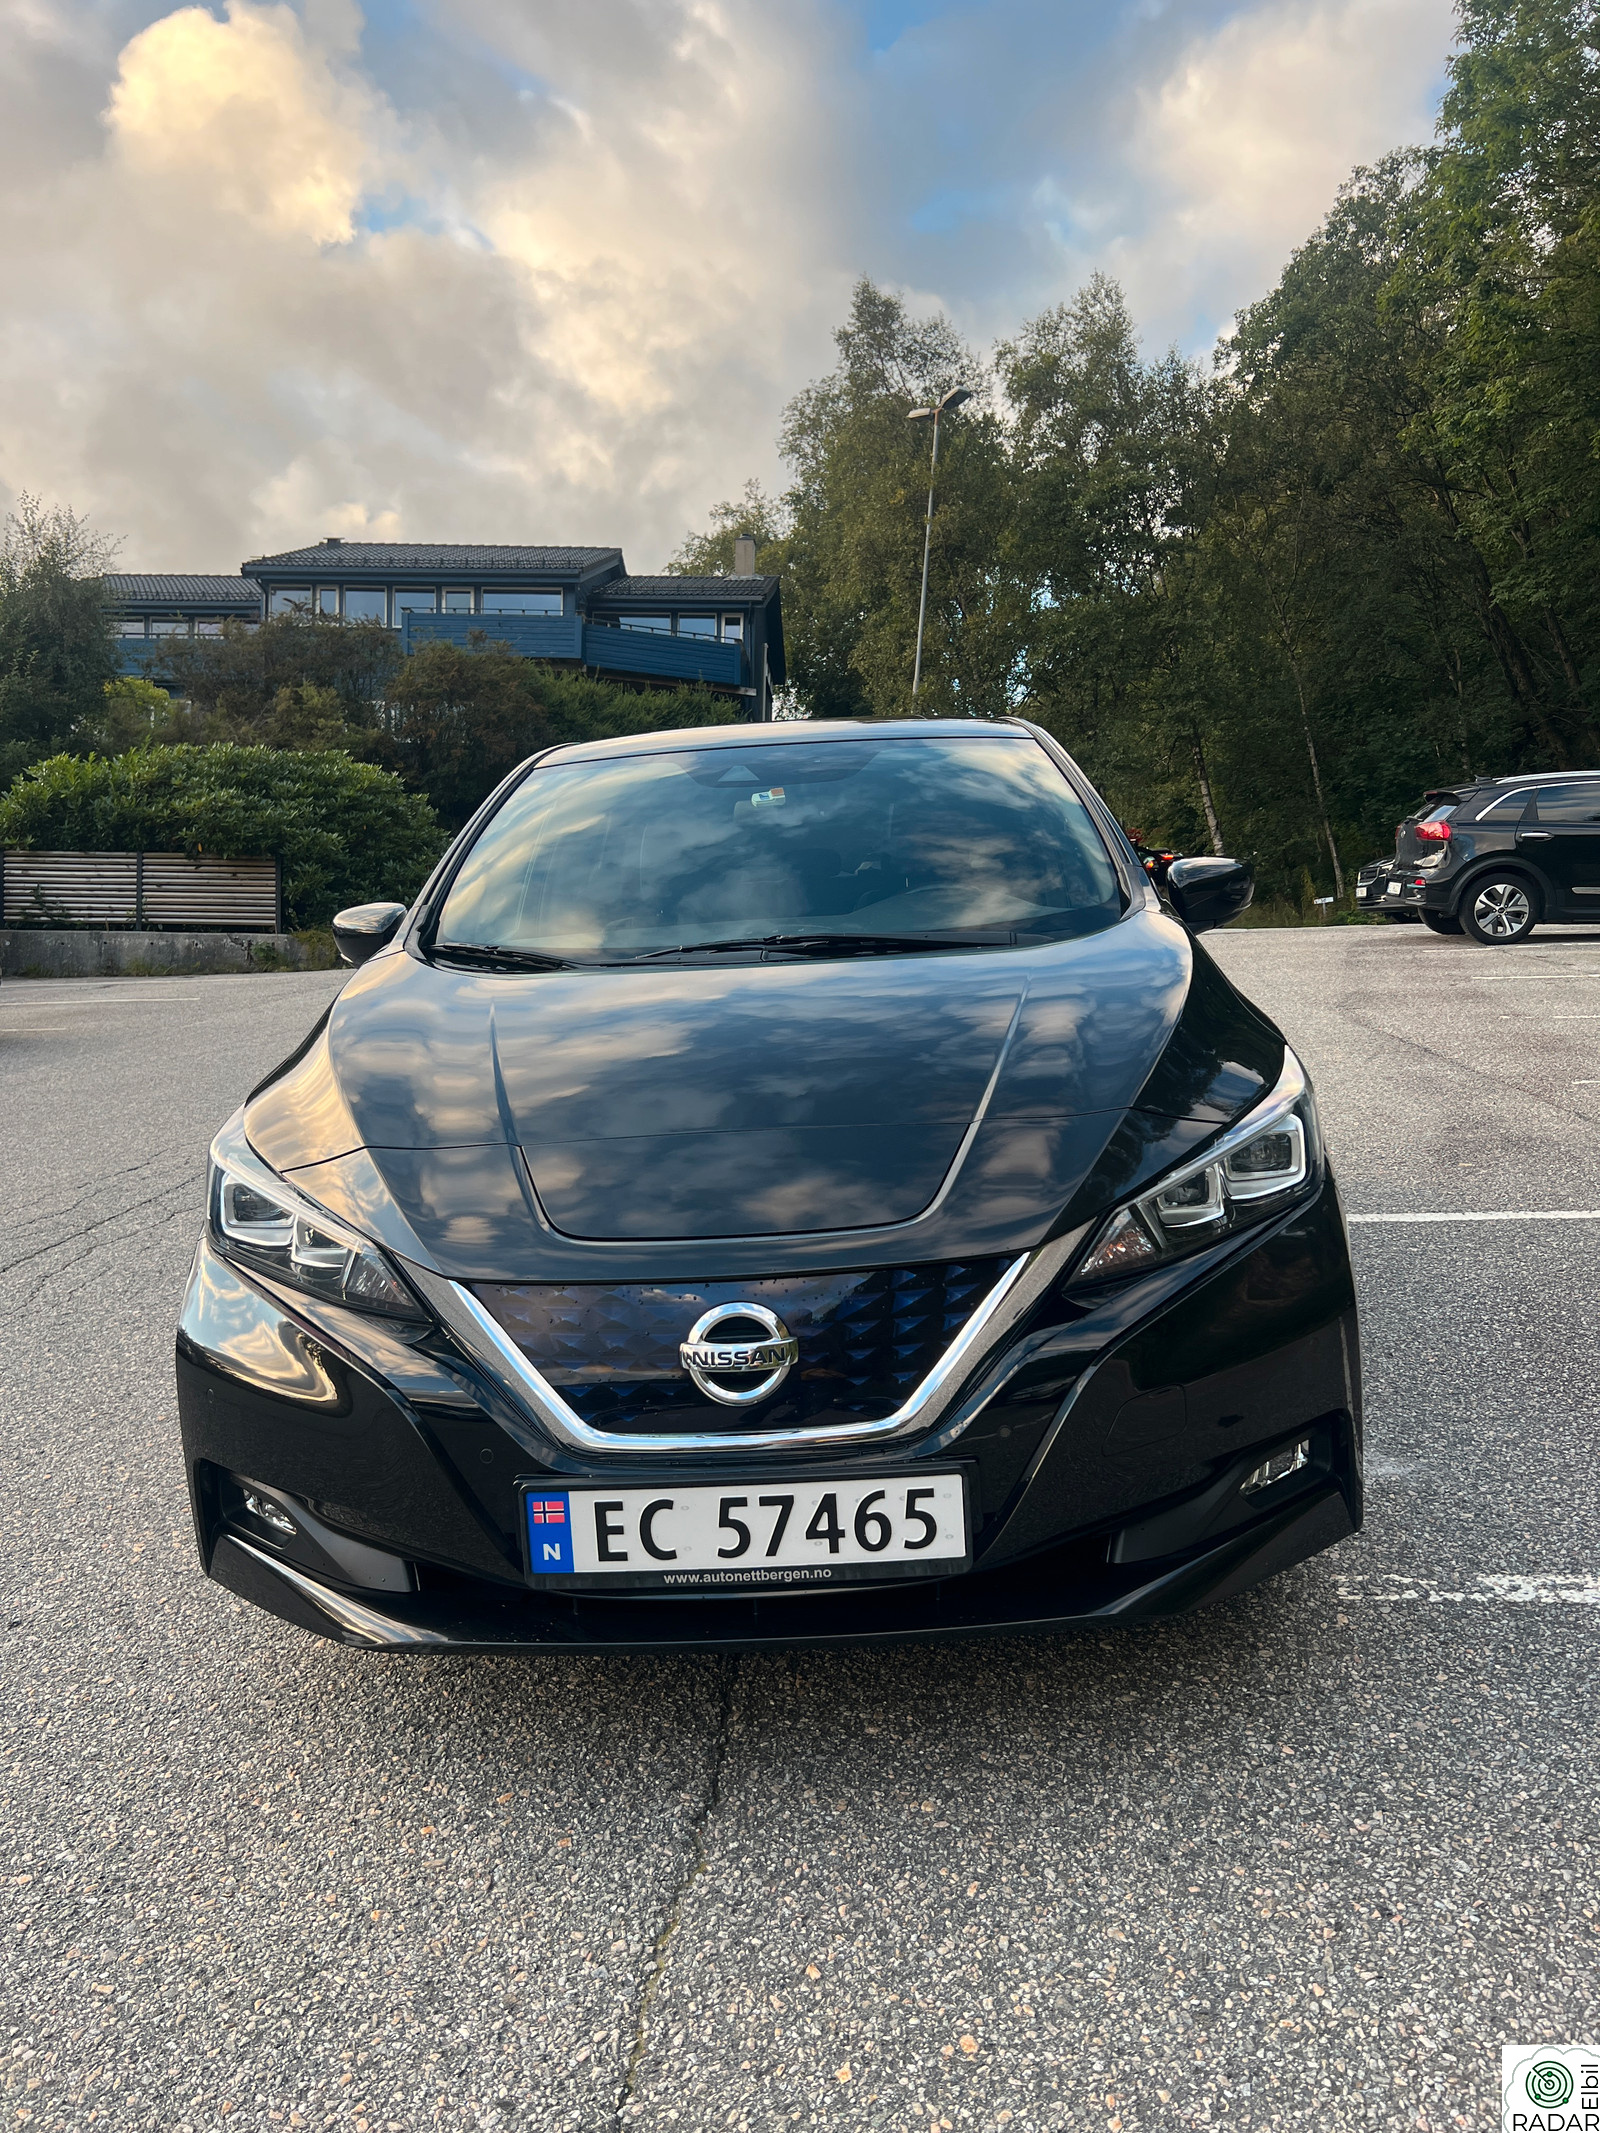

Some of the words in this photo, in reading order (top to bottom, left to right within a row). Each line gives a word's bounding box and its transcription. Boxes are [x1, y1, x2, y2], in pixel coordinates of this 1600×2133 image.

[692, 1347, 785, 1366] NISSAN
[594, 1499, 677, 1562] EC
[717, 1488, 937, 1559] 57465
[543, 1543, 561, 1560] N
[664, 1568, 832, 1583] www.autonettbergen.no
